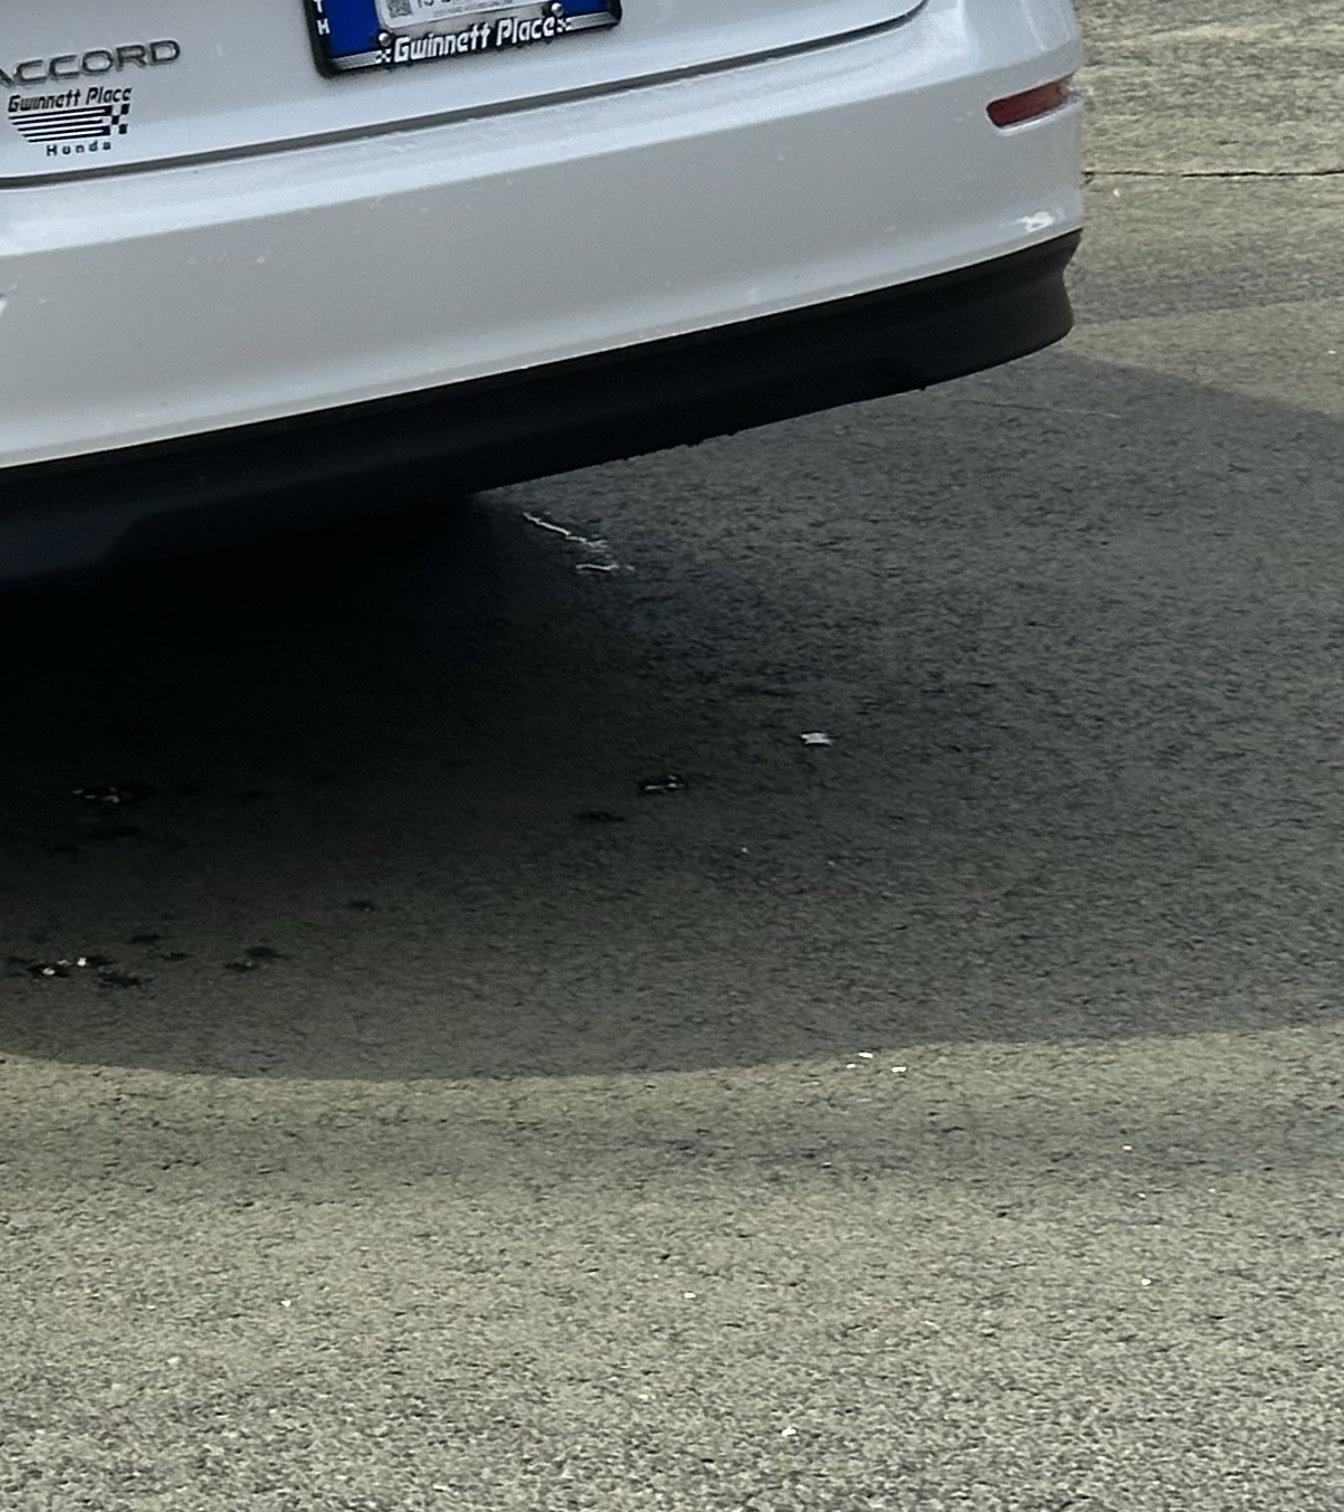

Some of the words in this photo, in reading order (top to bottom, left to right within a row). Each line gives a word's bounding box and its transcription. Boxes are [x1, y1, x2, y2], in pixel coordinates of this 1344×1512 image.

[393, 28, 492, 65] Gwinnett
[496, 15, 557, 48] Place
[7, 88, 82, 114] Gwinnett
[85, 86, 134, 106] Place
[46, 140, 113, 158] Honda
